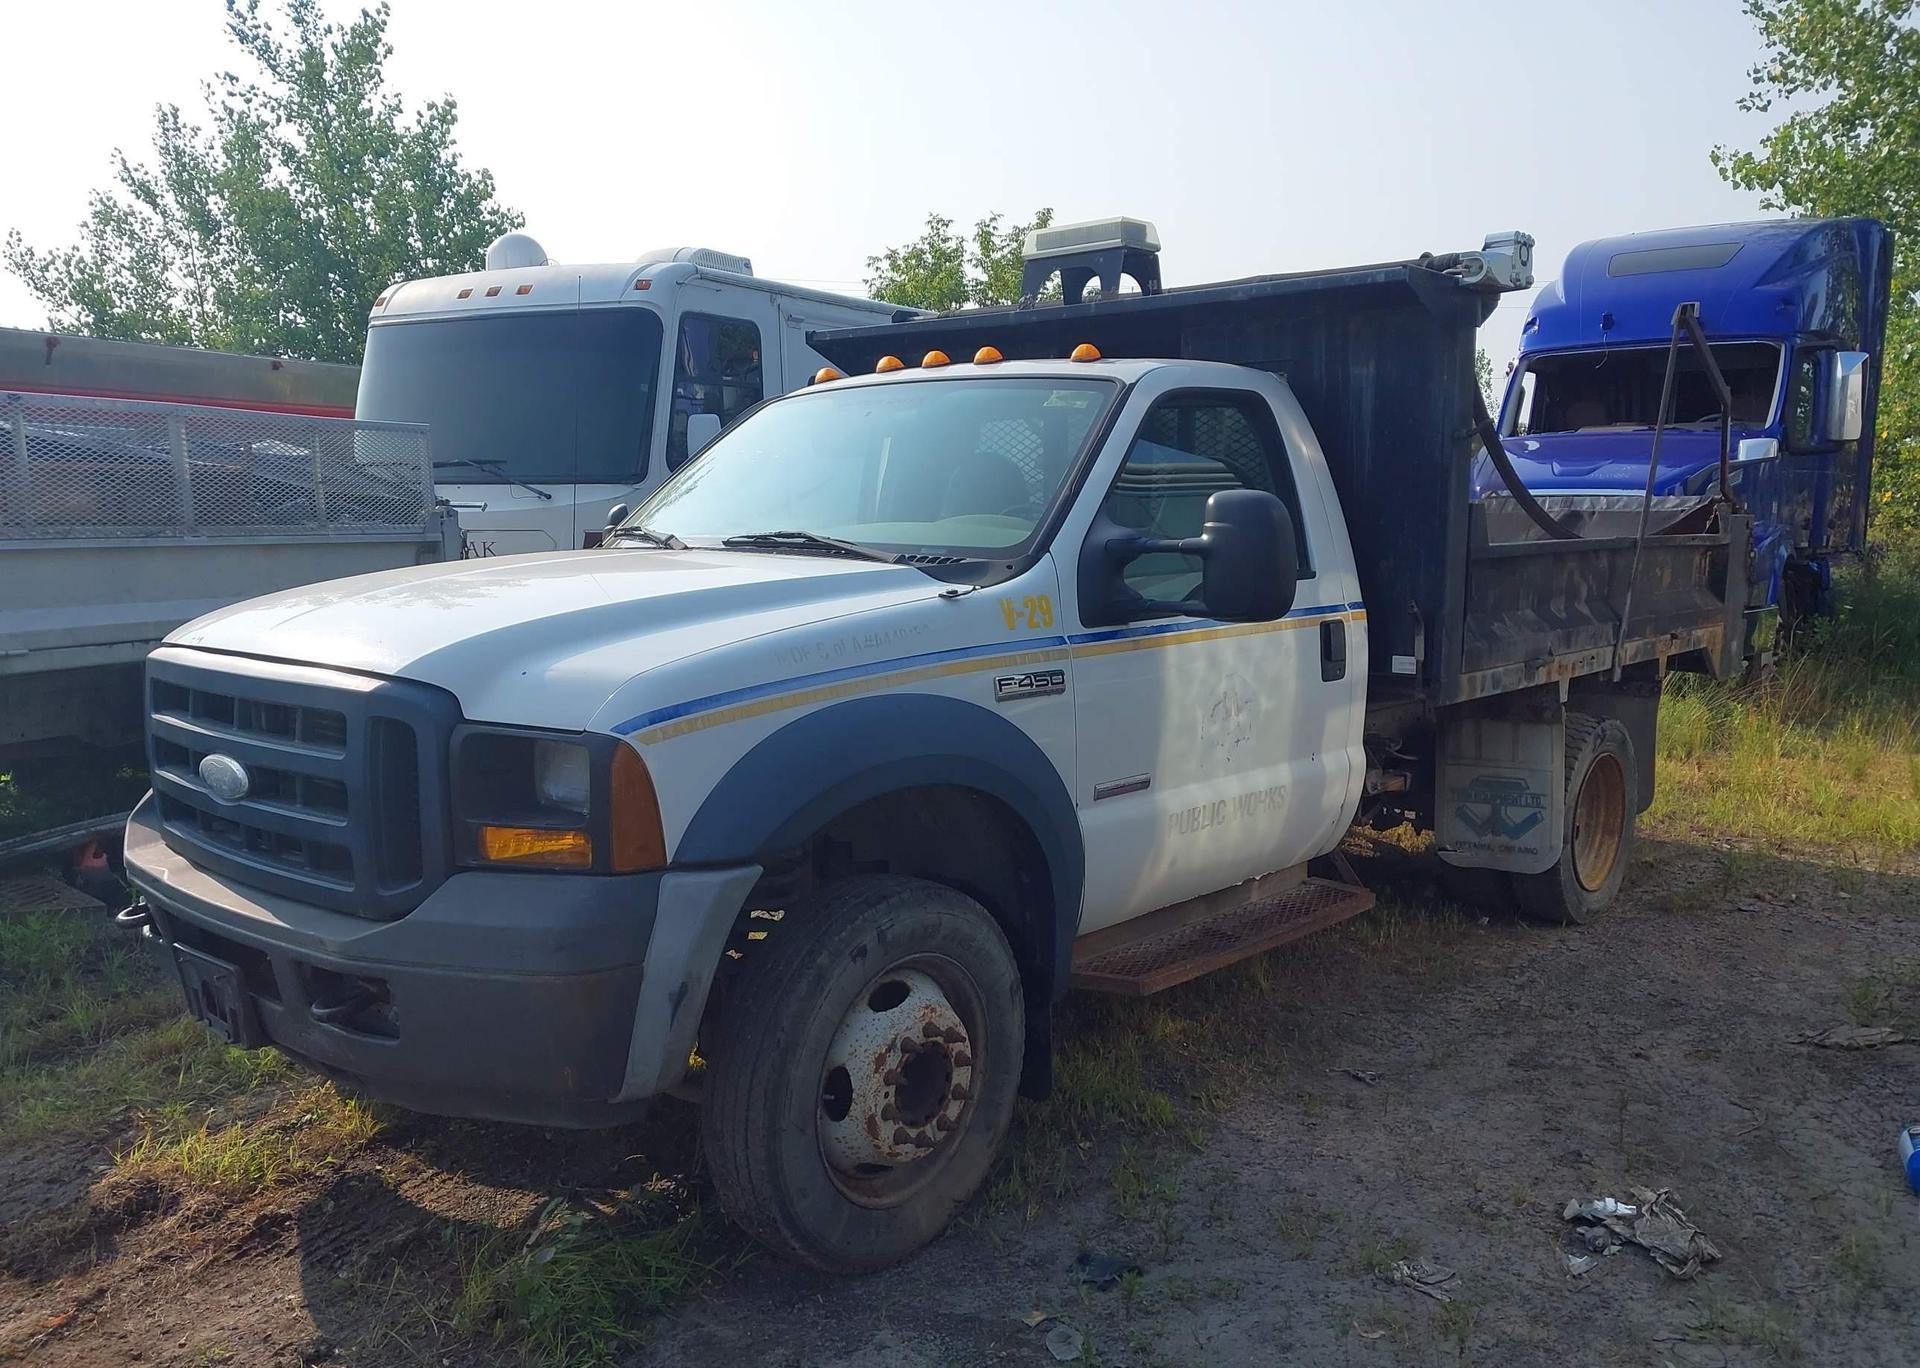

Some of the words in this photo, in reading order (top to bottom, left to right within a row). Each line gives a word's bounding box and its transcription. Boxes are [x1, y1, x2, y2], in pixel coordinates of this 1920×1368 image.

[999, 595, 1054, 630] V-29
[997, 674, 1065, 692] F-450
[1168, 799, 1227, 838] PUBLIC
